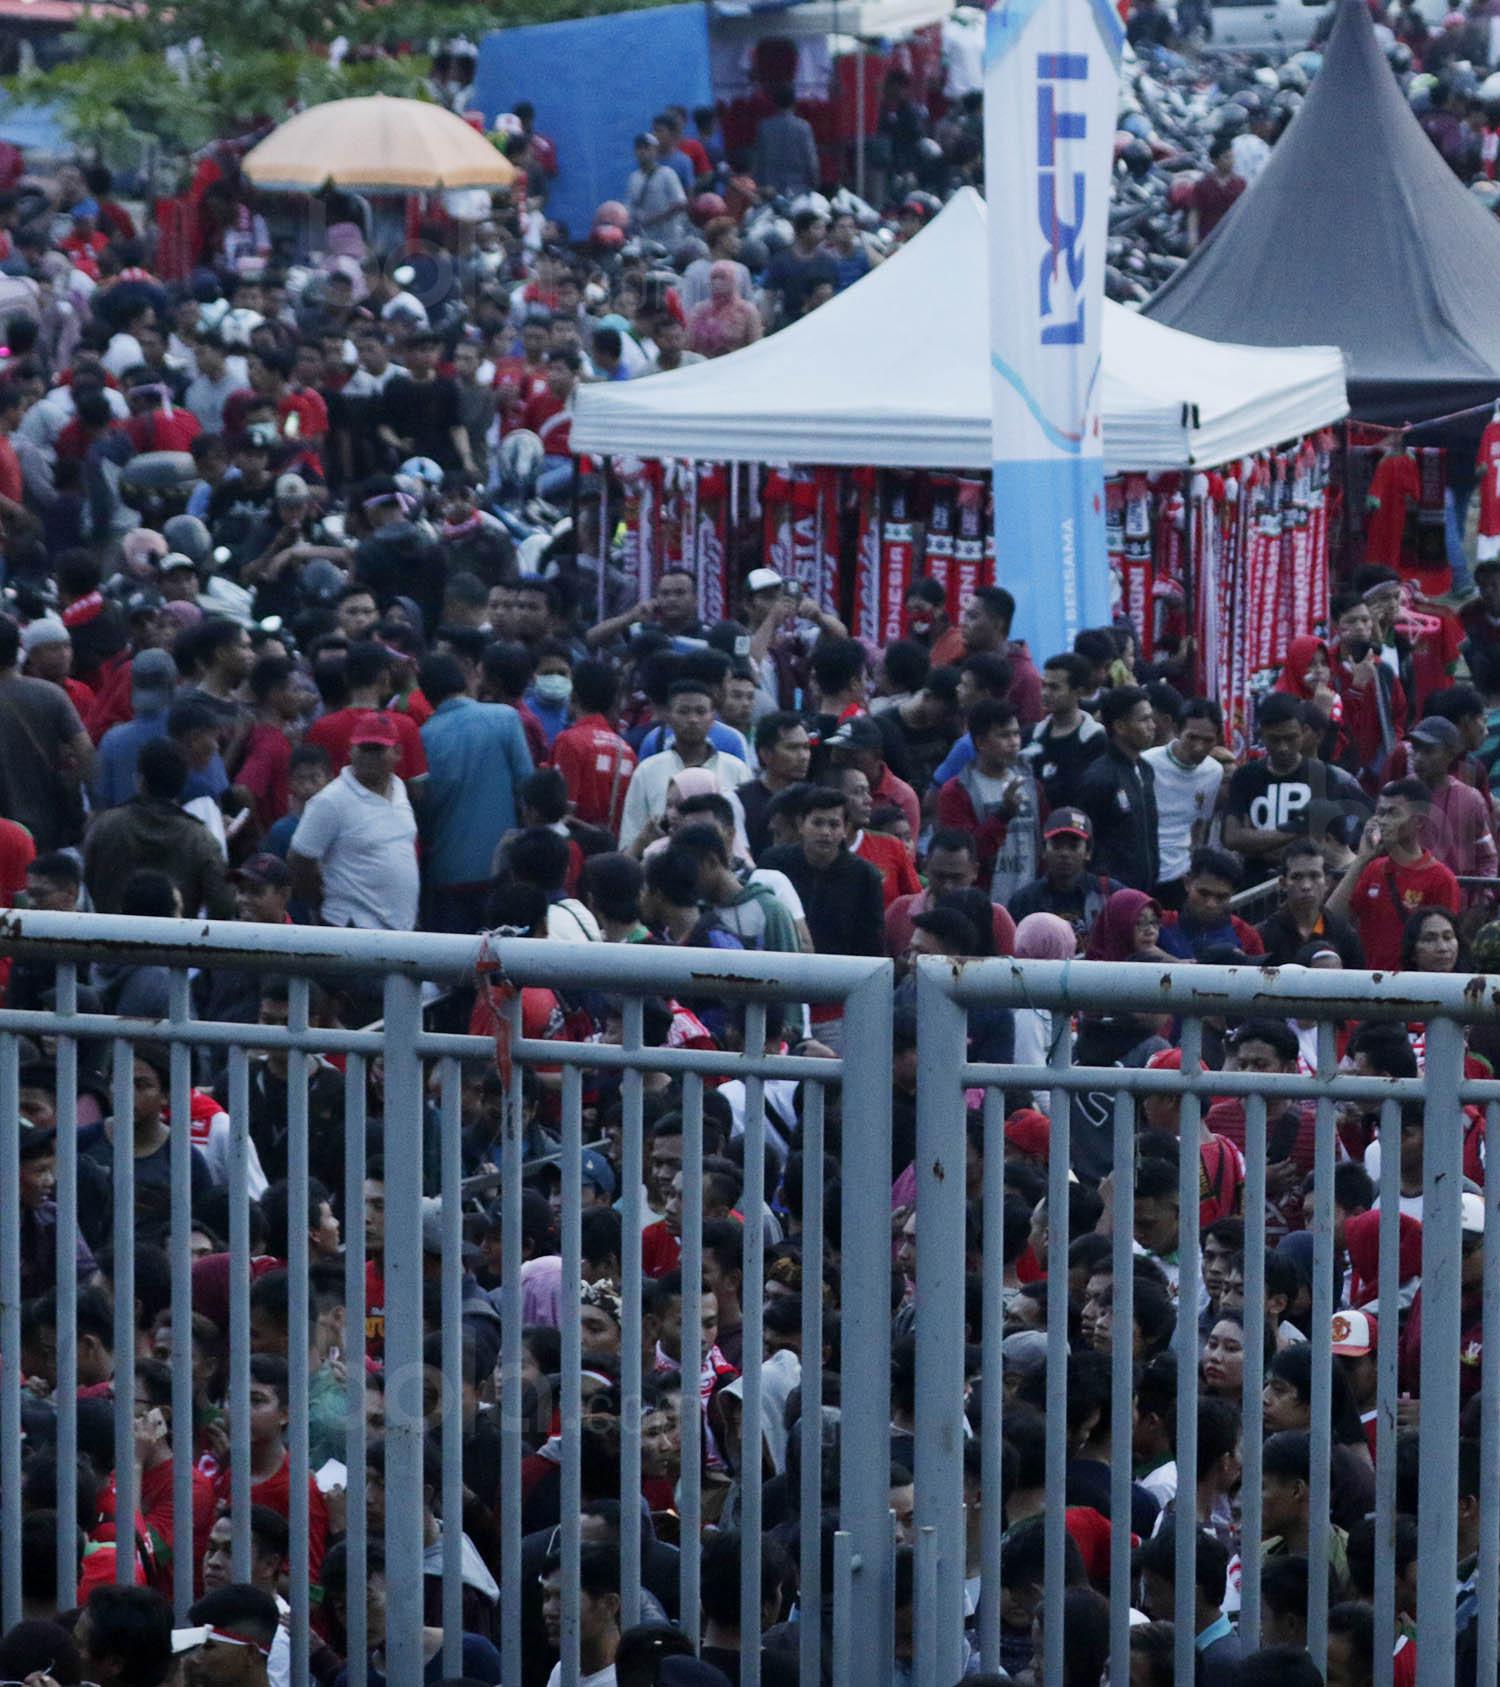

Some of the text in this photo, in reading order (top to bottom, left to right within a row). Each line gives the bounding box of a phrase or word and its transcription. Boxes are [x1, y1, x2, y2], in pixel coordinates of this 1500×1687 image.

[1037, 52, 1088, 345] RCTI
[1061, 518, 1077, 621] BERSAMA
[1250, 782, 1312, 830] dP
